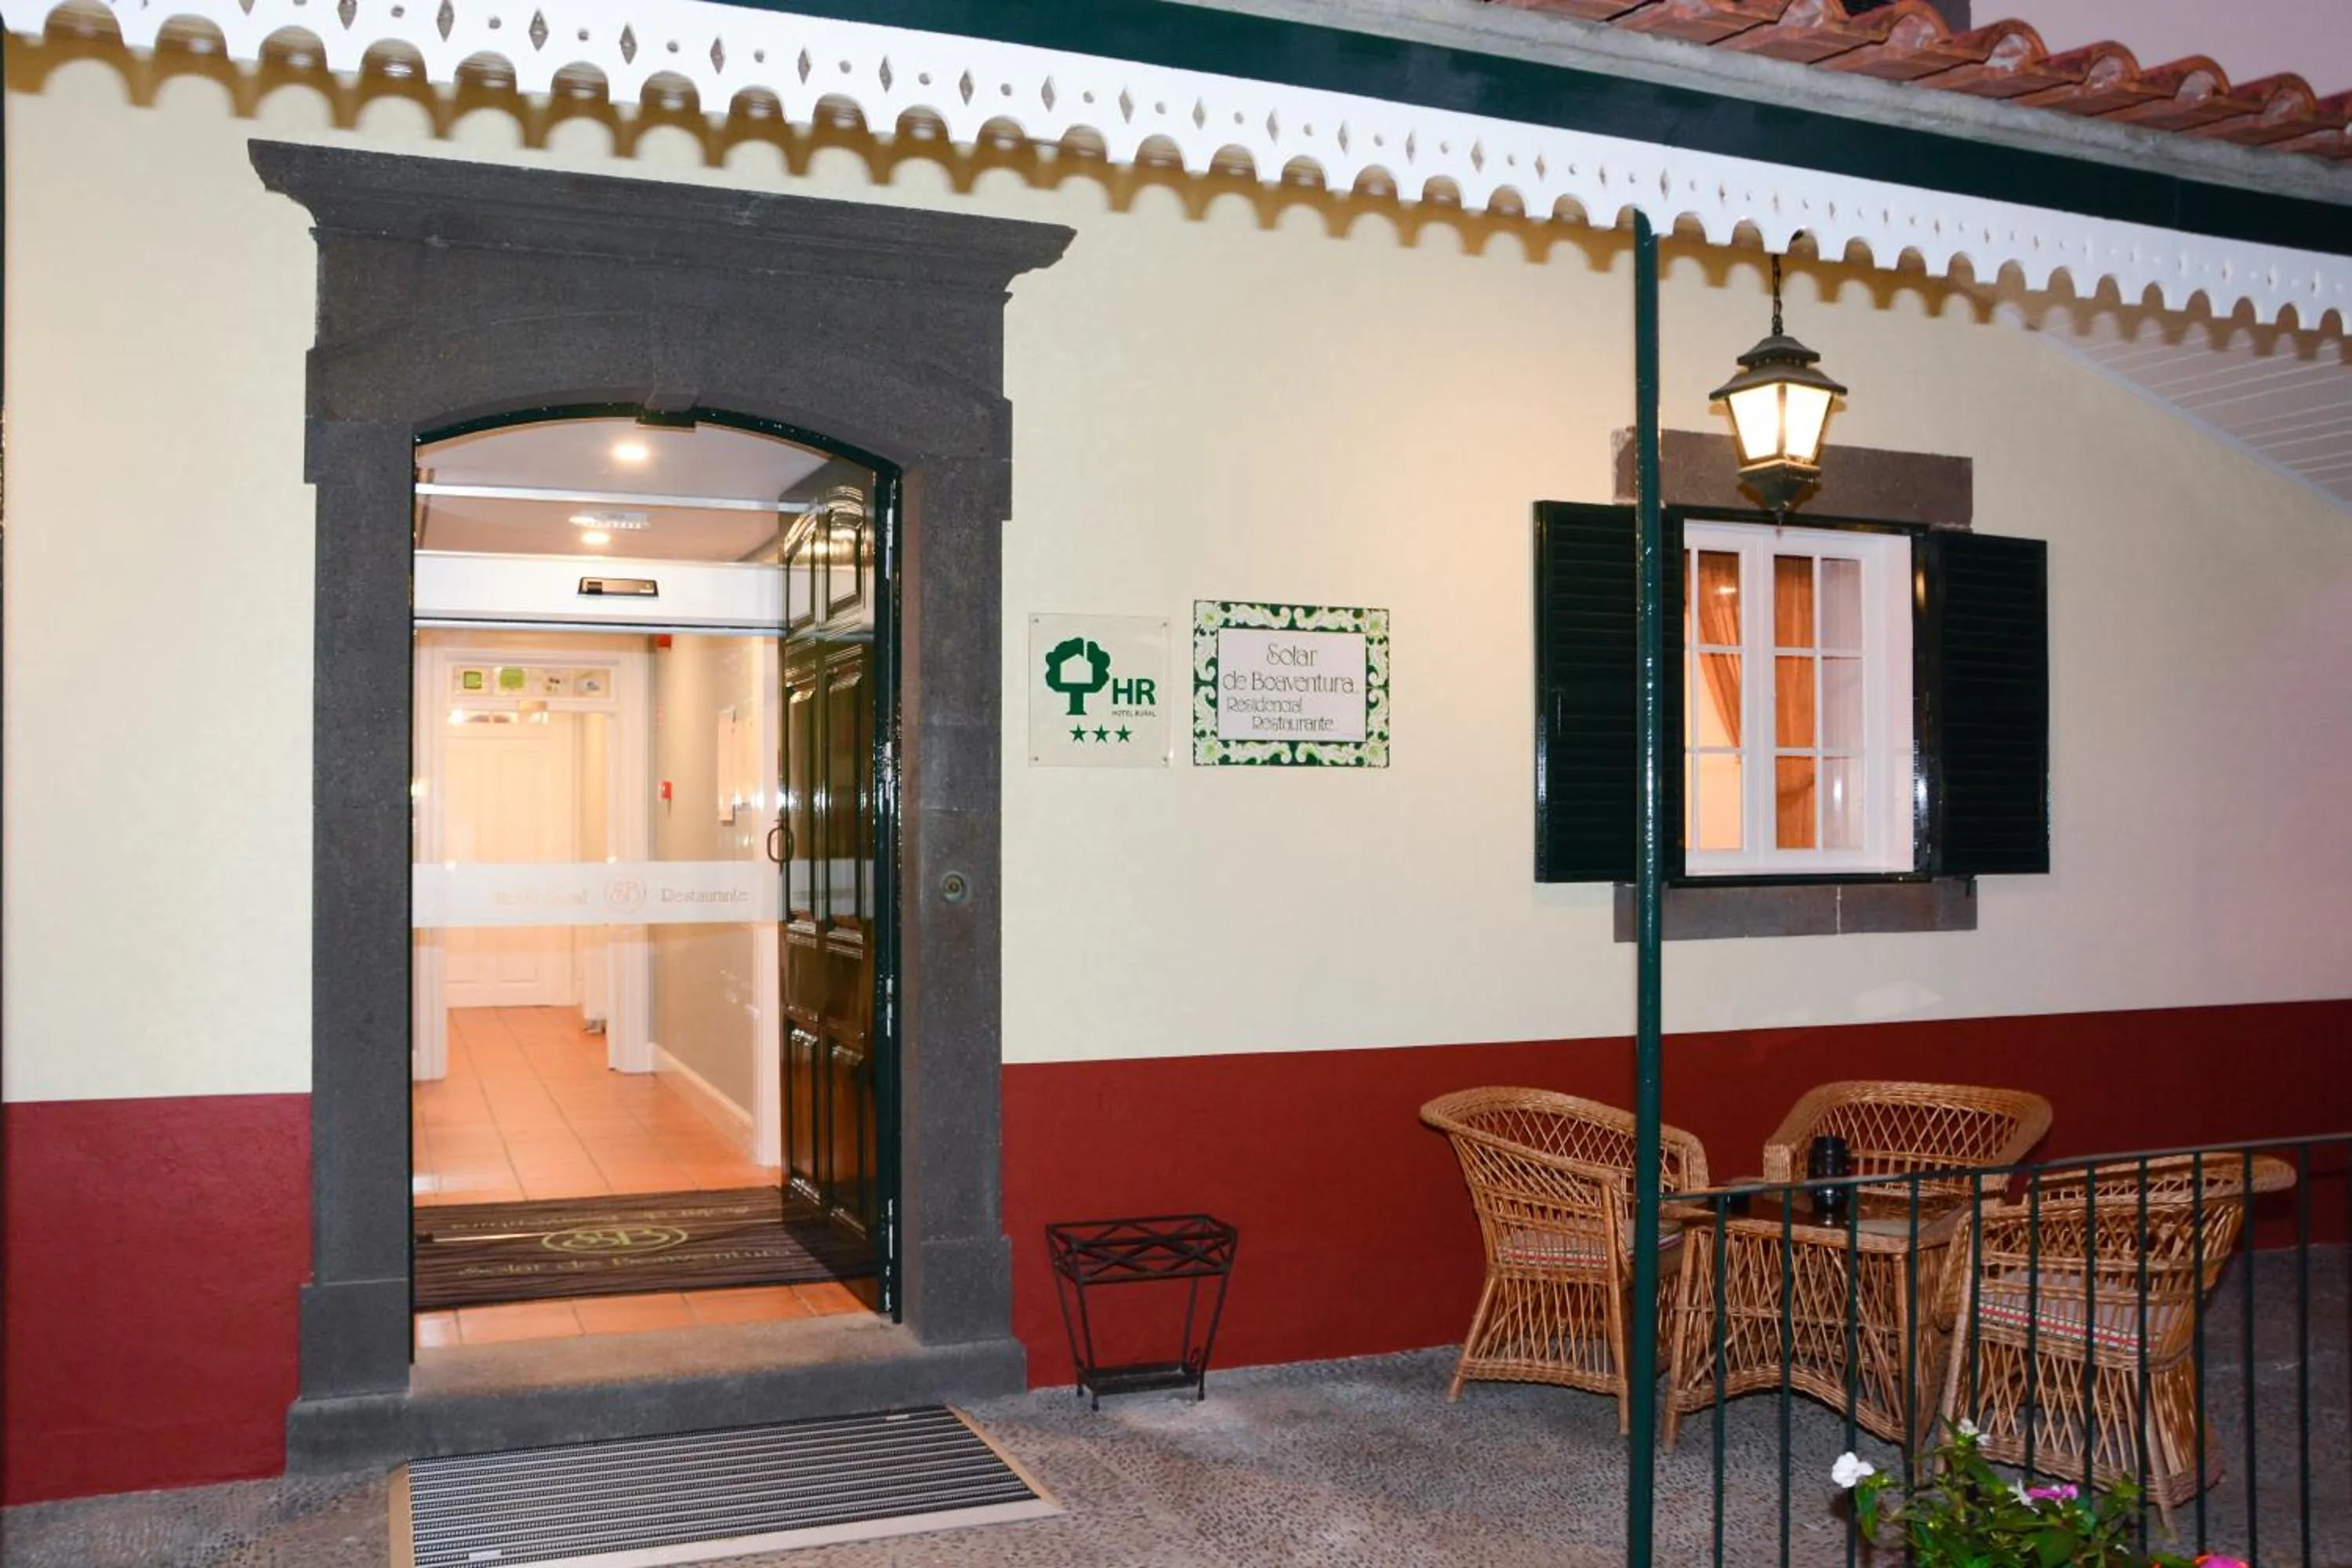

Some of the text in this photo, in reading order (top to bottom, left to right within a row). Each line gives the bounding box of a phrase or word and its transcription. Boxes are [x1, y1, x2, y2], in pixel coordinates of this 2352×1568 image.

[1267, 643, 1317, 666] Solar
[1112, 677, 1156, 705] HR
[1222, 670, 1247, 691] de
[1226, 696, 1302, 713] Residencial
[1251, 716, 1334, 731] Restaurante
